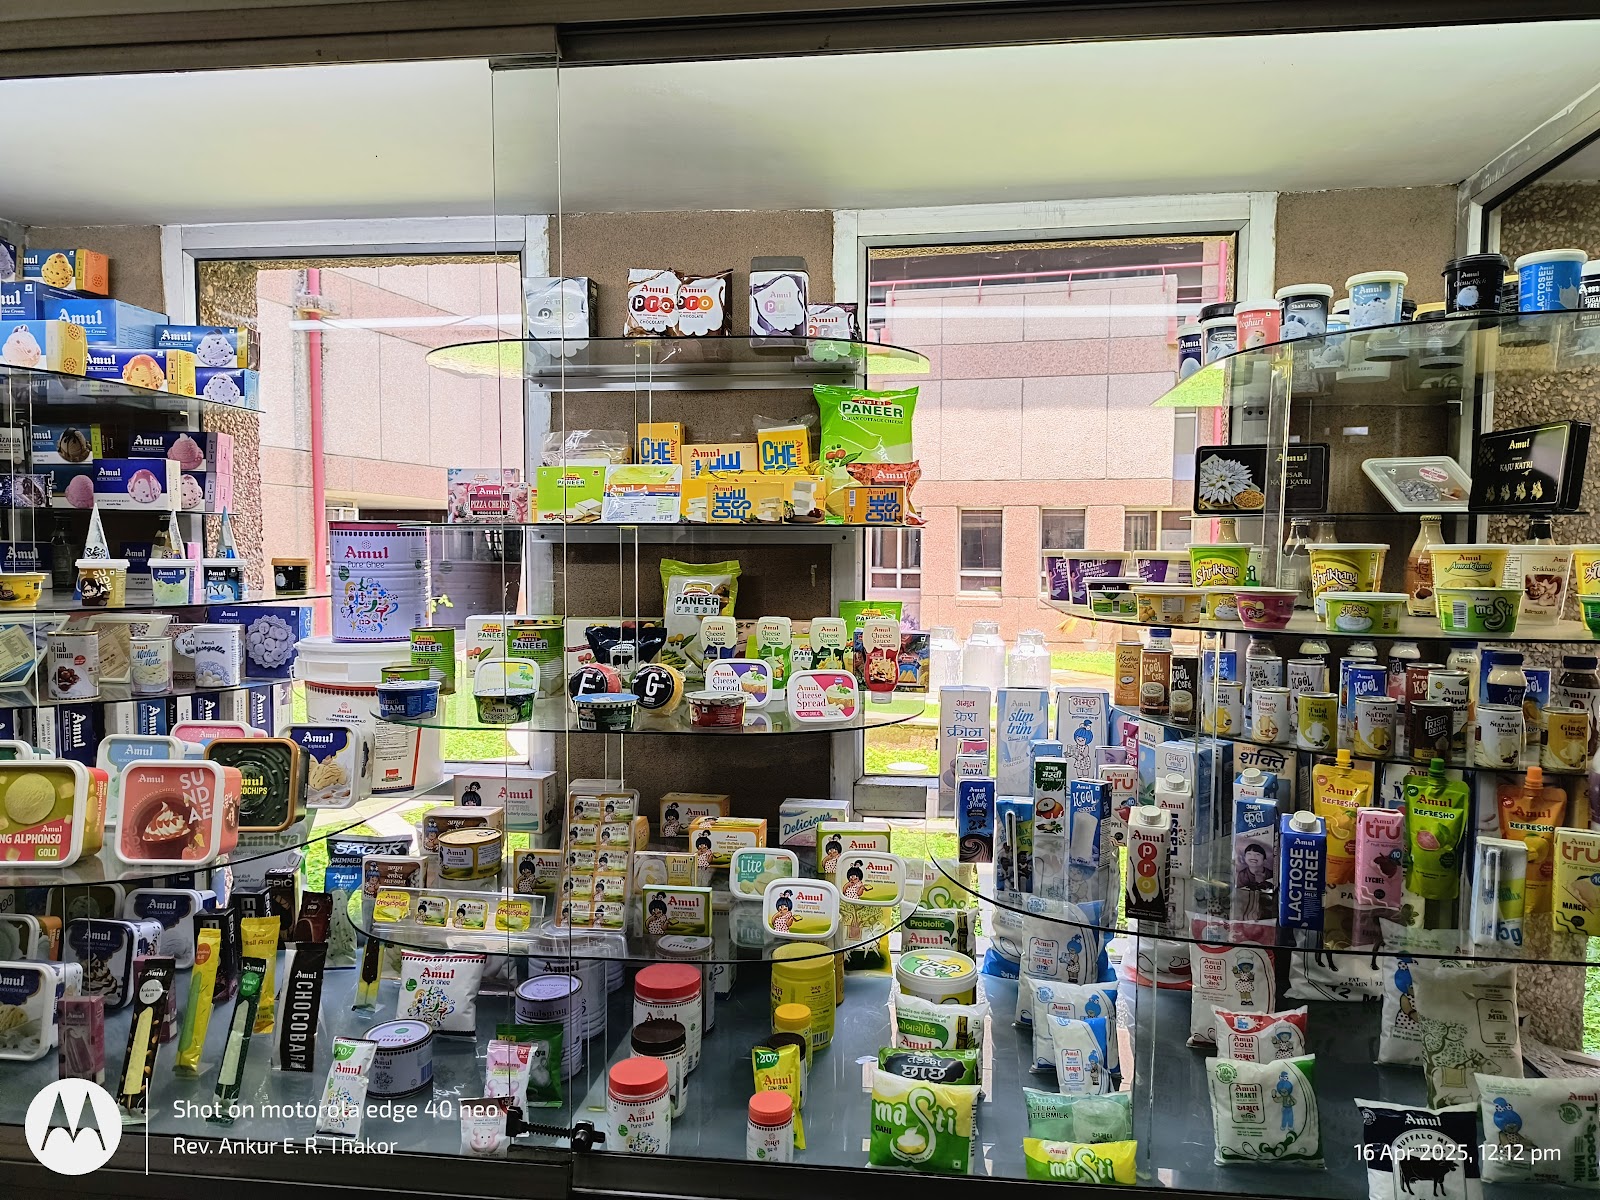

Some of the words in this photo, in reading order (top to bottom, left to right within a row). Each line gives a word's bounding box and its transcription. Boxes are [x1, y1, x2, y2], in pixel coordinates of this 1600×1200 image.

[1358, 285, 1382, 295] Amul
[58, 308, 102, 325] Amul
[1240, 318, 1264, 330] Yoghurt
[161, 329, 192, 341] Amul
[842, 403, 903, 418] PANEER
[134, 435, 163, 446] Amul
[1508, 438, 1530, 450] Amul
[641, 437, 670, 461] CHE
[691, 449, 720, 457] Amul
[762, 440, 797, 466] CHE
[98, 467, 120, 476] Amul
[1500, 463, 1514, 472] KAJU
[1516, 460, 1533, 470] KATRI
[478, 487, 502, 495] Amul
[470, 500, 486, 508] PIZZA
[711, 491, 733, 518] CHE
[731, 488, 751, 519] ESE
[344, 546, 388, 558] Amul
[1195, 565, 1239, 586] Shrikhand
[1312, 569, 1358, 590] Shrikhand
[676, 596, 719, 605] PANEER
[512, 641, 548, 650] PANEER
[1354, 680, 1378, 695] KOOL
[796, 692, 822, 700] Cheese
[797, 699, 826, 709] Spread
[1255, 700, 1278, 709] Honey
[1009, 707, 1035, 722] slim
[1007, 725, 1032, 735] trim
[302, 731, 333, 744] Amul
[138, 774, 164, 783] Amul
[1072, 791, 1097, 806] KOOL
[1321, 796, 1360, 808] REFRESHO
[1416, 795, 1452, 807] Amul
[1414, 808, 1455, 819] REFRESHO
[1511, 806, 1551, 818] Amul
[41, 825, 62, 833] Amul
[783, 812, 832, 835] Delicious
[1509, 822, 1555, 832] REFRESHO
[1366, 821, 1400, 839] tru
[14, 834, 61, 844] ALPHONSO
[1131, 830, 1165, 843] Amul
[1294, 838, 1315, 846] Amul
[1570, 838, 1595, 847] Amul
[334, 842, 404, 855] SAGAR
[849, 841, 876, 849] Amul
[1562, 842, 1600, 861] tru
[741, 859, 762, 874] Lite
[866, 862, 893, 871] Amul
[1304, 849, 1319, 891] FREE
[1288, 847, 1304, 921] LACTOSE
[668, 896, 699, 907] Amul
[796, 892, 823, 901] Amul
[1562, 902, 1586, 911] MANGO
[910, 919, 946, 929] Probiotic
[909, 933, 943, 945] Amul
[296, 970, 317, 979] Amul
[420, 967, 455, 979] Amul
[289, 980, 313, 1061] CHOCOBAR
[763, 1075, 792, 1086] Amul
[1235, 1084, 1257, 1092] Amul
[1568, 1092, 1598, 1101] Amul
[627, 1111, 655, 1123] Amul
[1405, 1113, 1441, 1126] Amul
[875, 1124, 892, 1135] DAHI
[1397, 1133, 1433, 1149] BUFFALO
